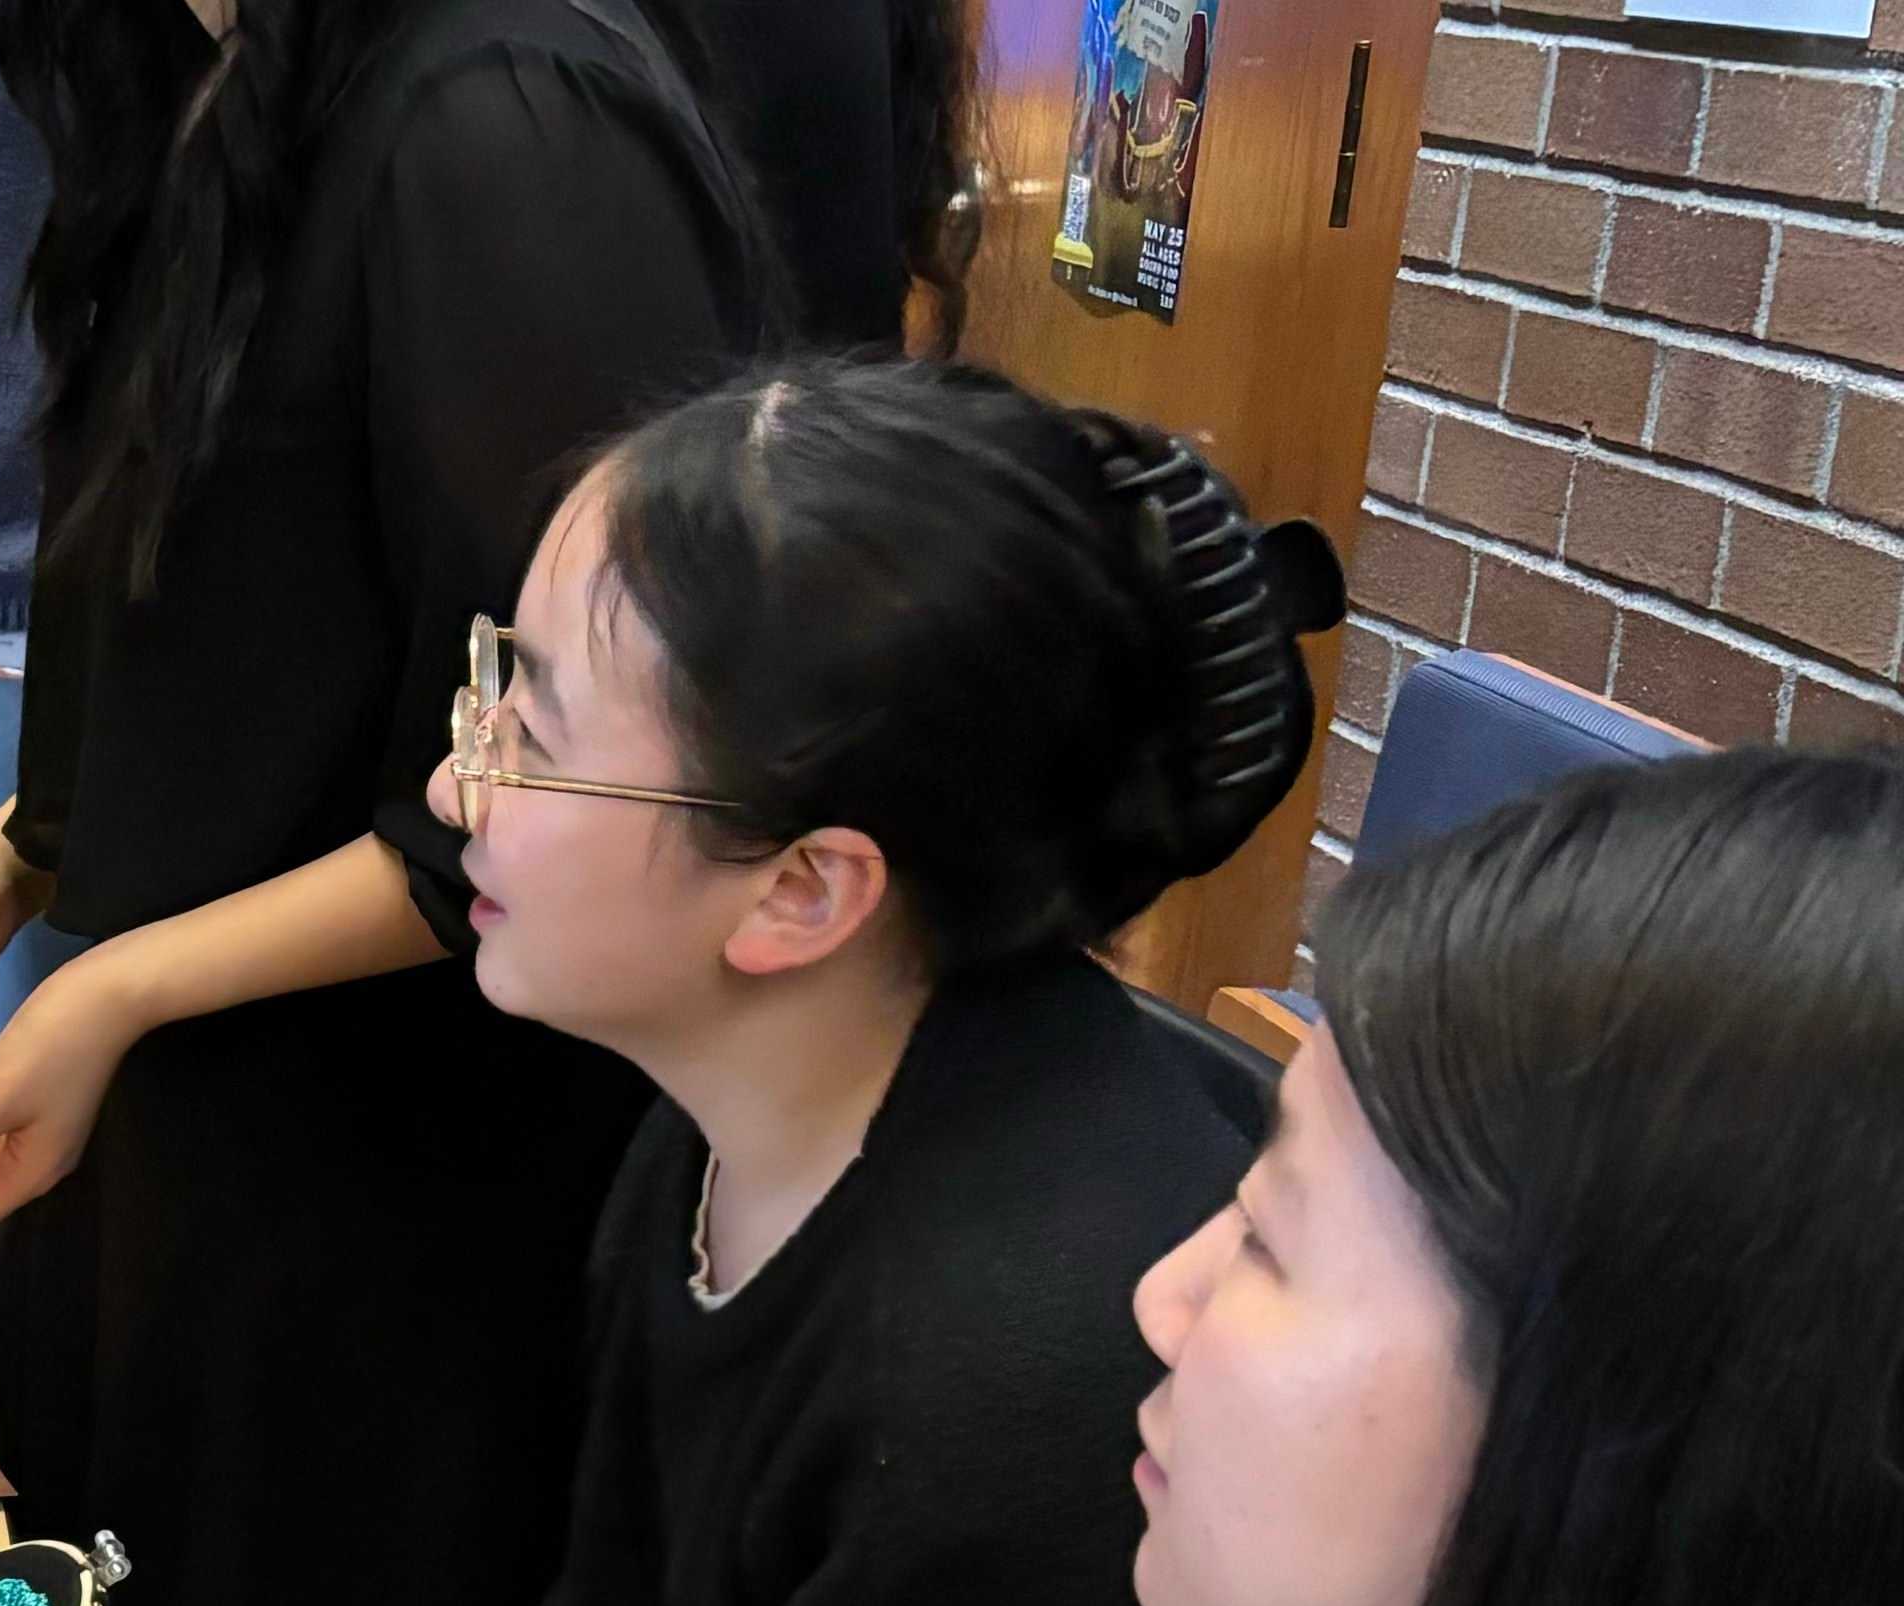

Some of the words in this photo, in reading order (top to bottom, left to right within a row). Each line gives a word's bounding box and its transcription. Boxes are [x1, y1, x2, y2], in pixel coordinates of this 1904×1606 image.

[1144, 219, 1166, 242] MAY
[1168, 227, 1184, 247] 25
[1142, 240, 1157, 257] ALL
